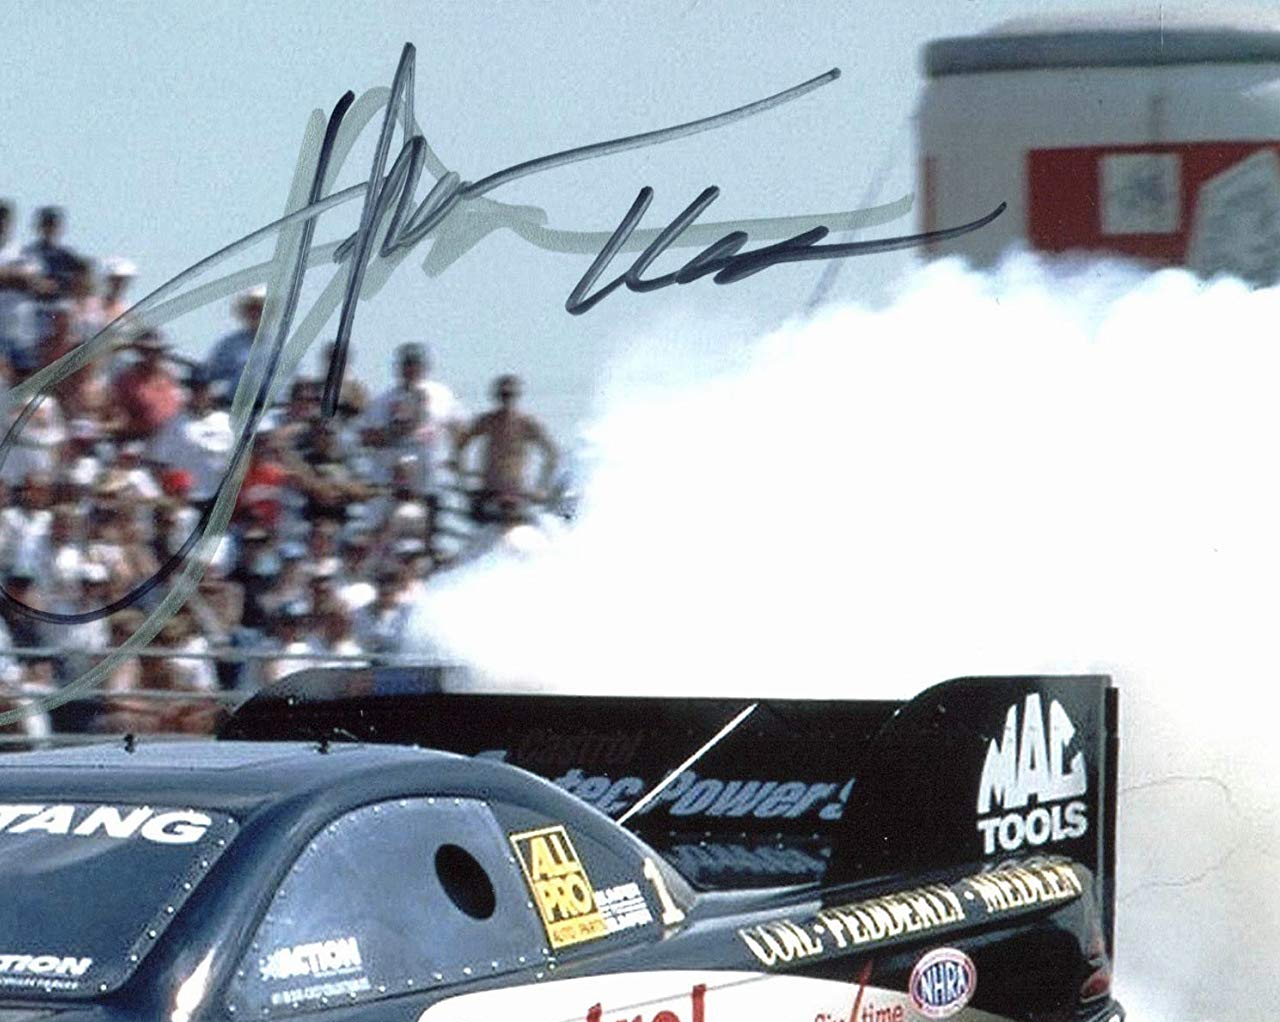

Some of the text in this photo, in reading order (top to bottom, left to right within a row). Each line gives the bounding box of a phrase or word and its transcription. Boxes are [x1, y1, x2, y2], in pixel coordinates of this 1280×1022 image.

[977, 692, 1088, 815] MAC
[977, 801, 1089, 855] TOOLS
[530, 833, 581, 881] ALL
[533, 872, 594, 924] PRO
[920, 961, 970, 1006] NHRA
